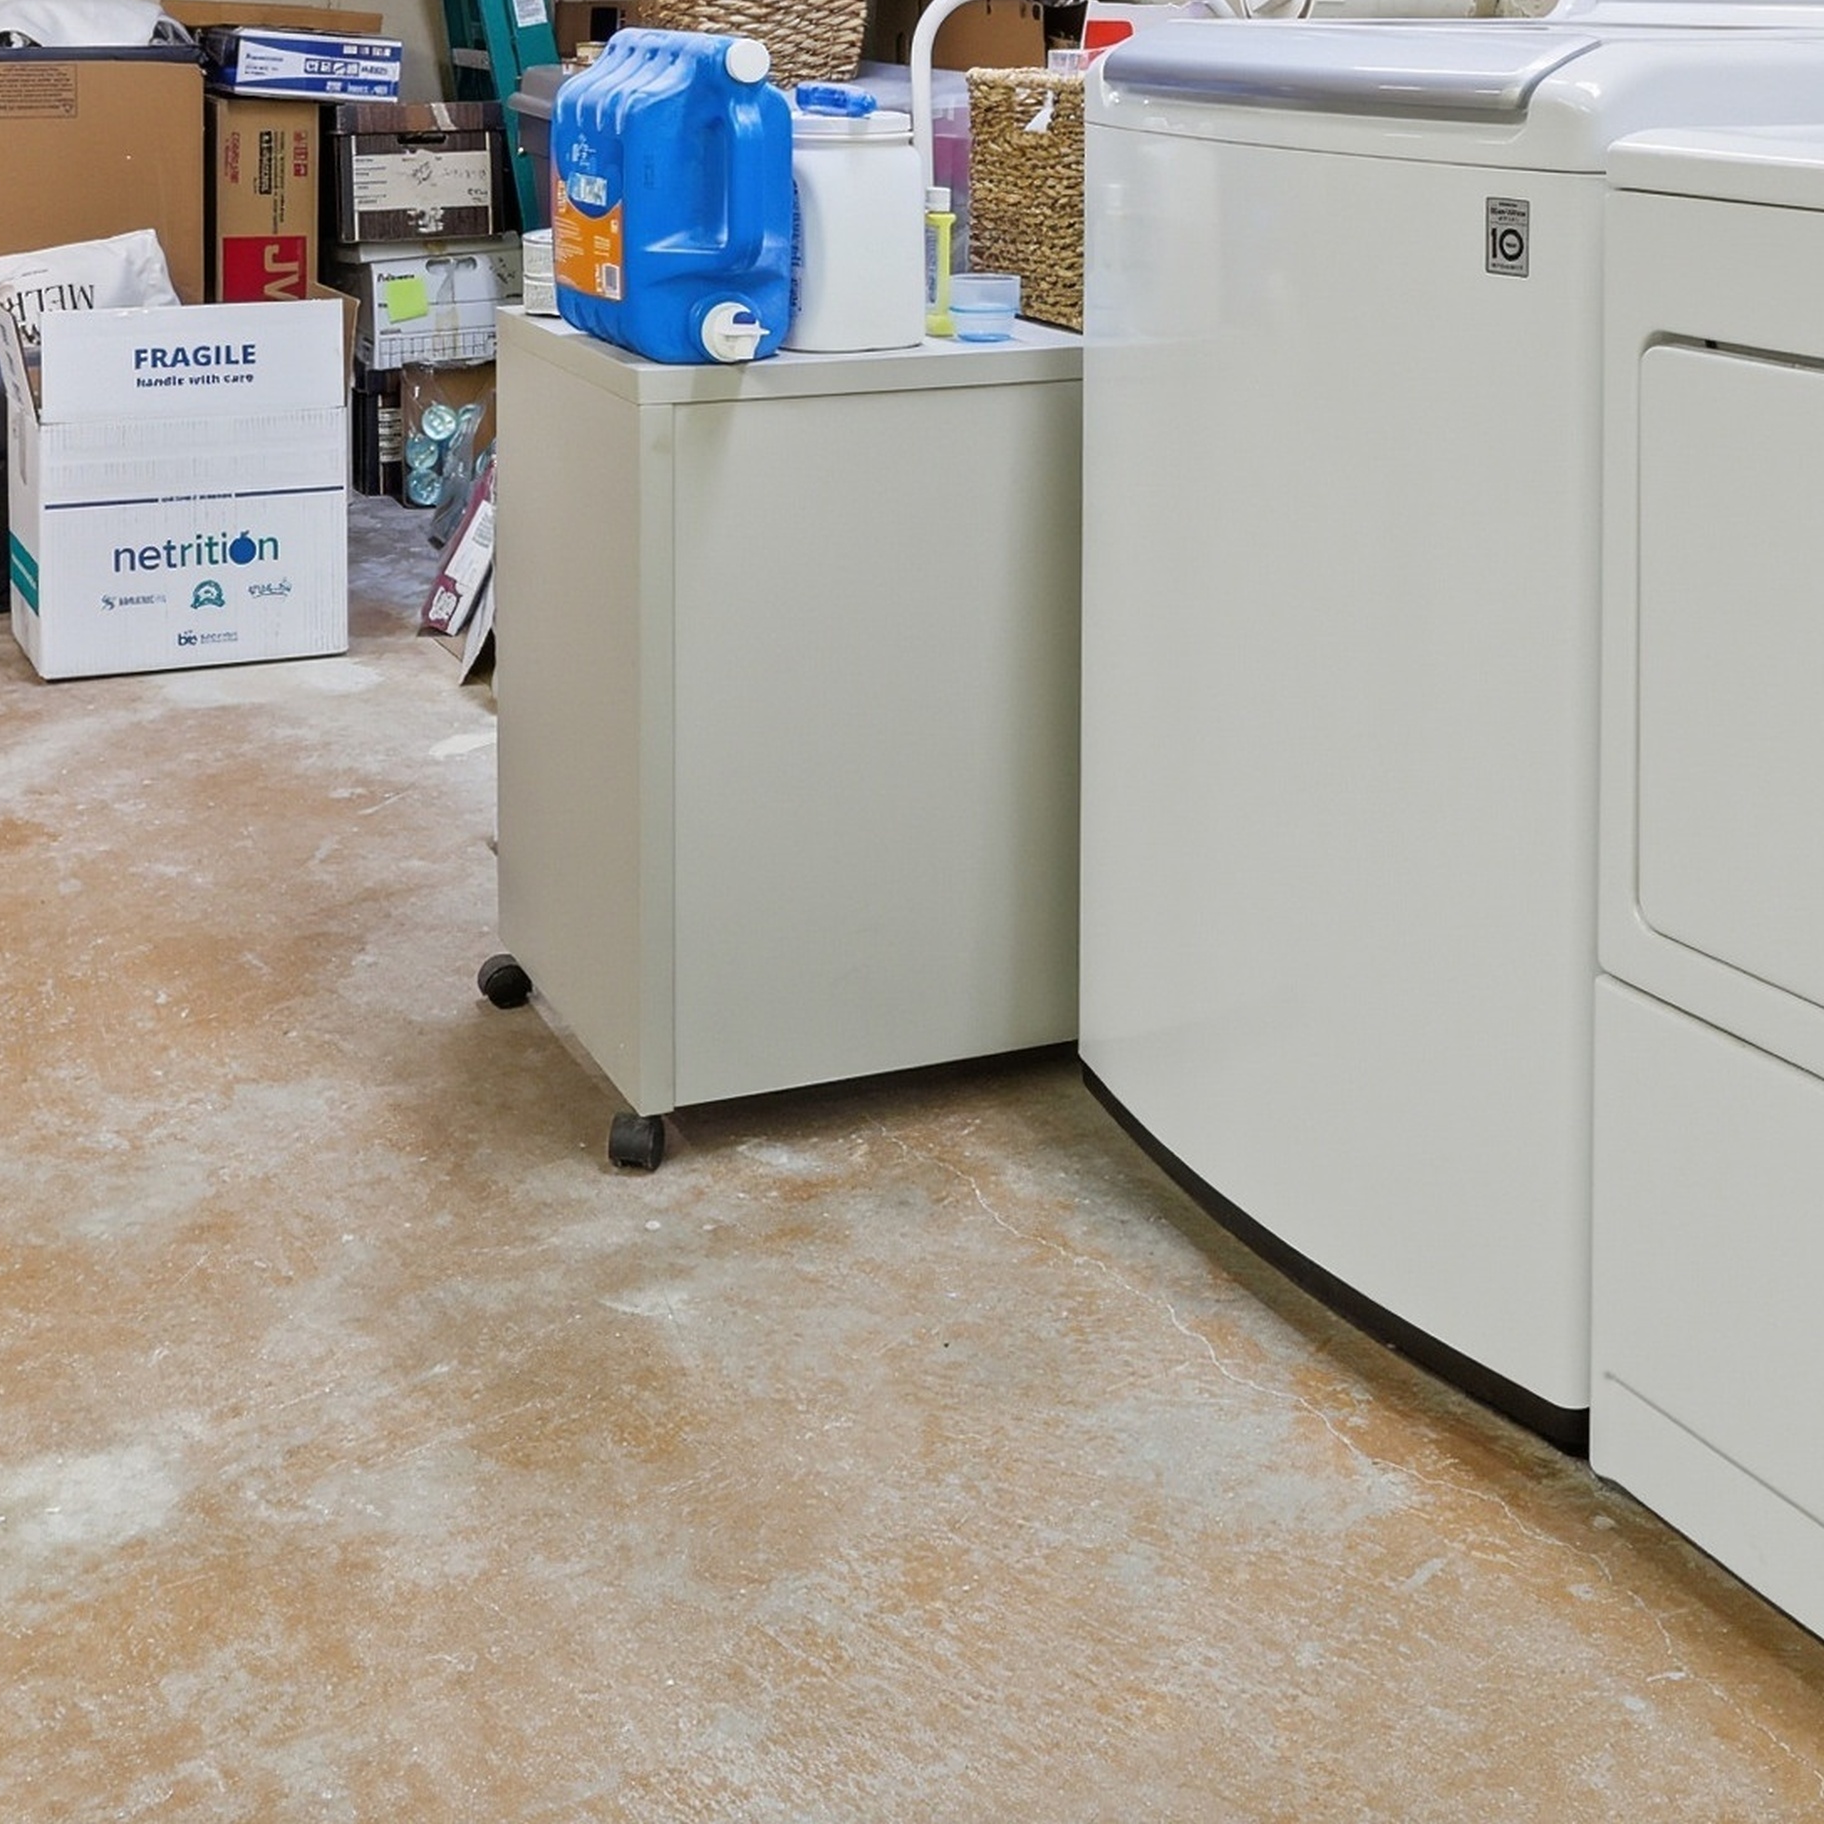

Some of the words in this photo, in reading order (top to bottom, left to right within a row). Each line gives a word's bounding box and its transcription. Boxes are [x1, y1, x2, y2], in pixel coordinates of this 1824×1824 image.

[134, 344, 256, 370] FRAGILE
[136, 376, 185, 388] handle
[189, 375, 221, 385] with
[224, 374, 254, 384] care
[114, 530, 279, 573] netrition
